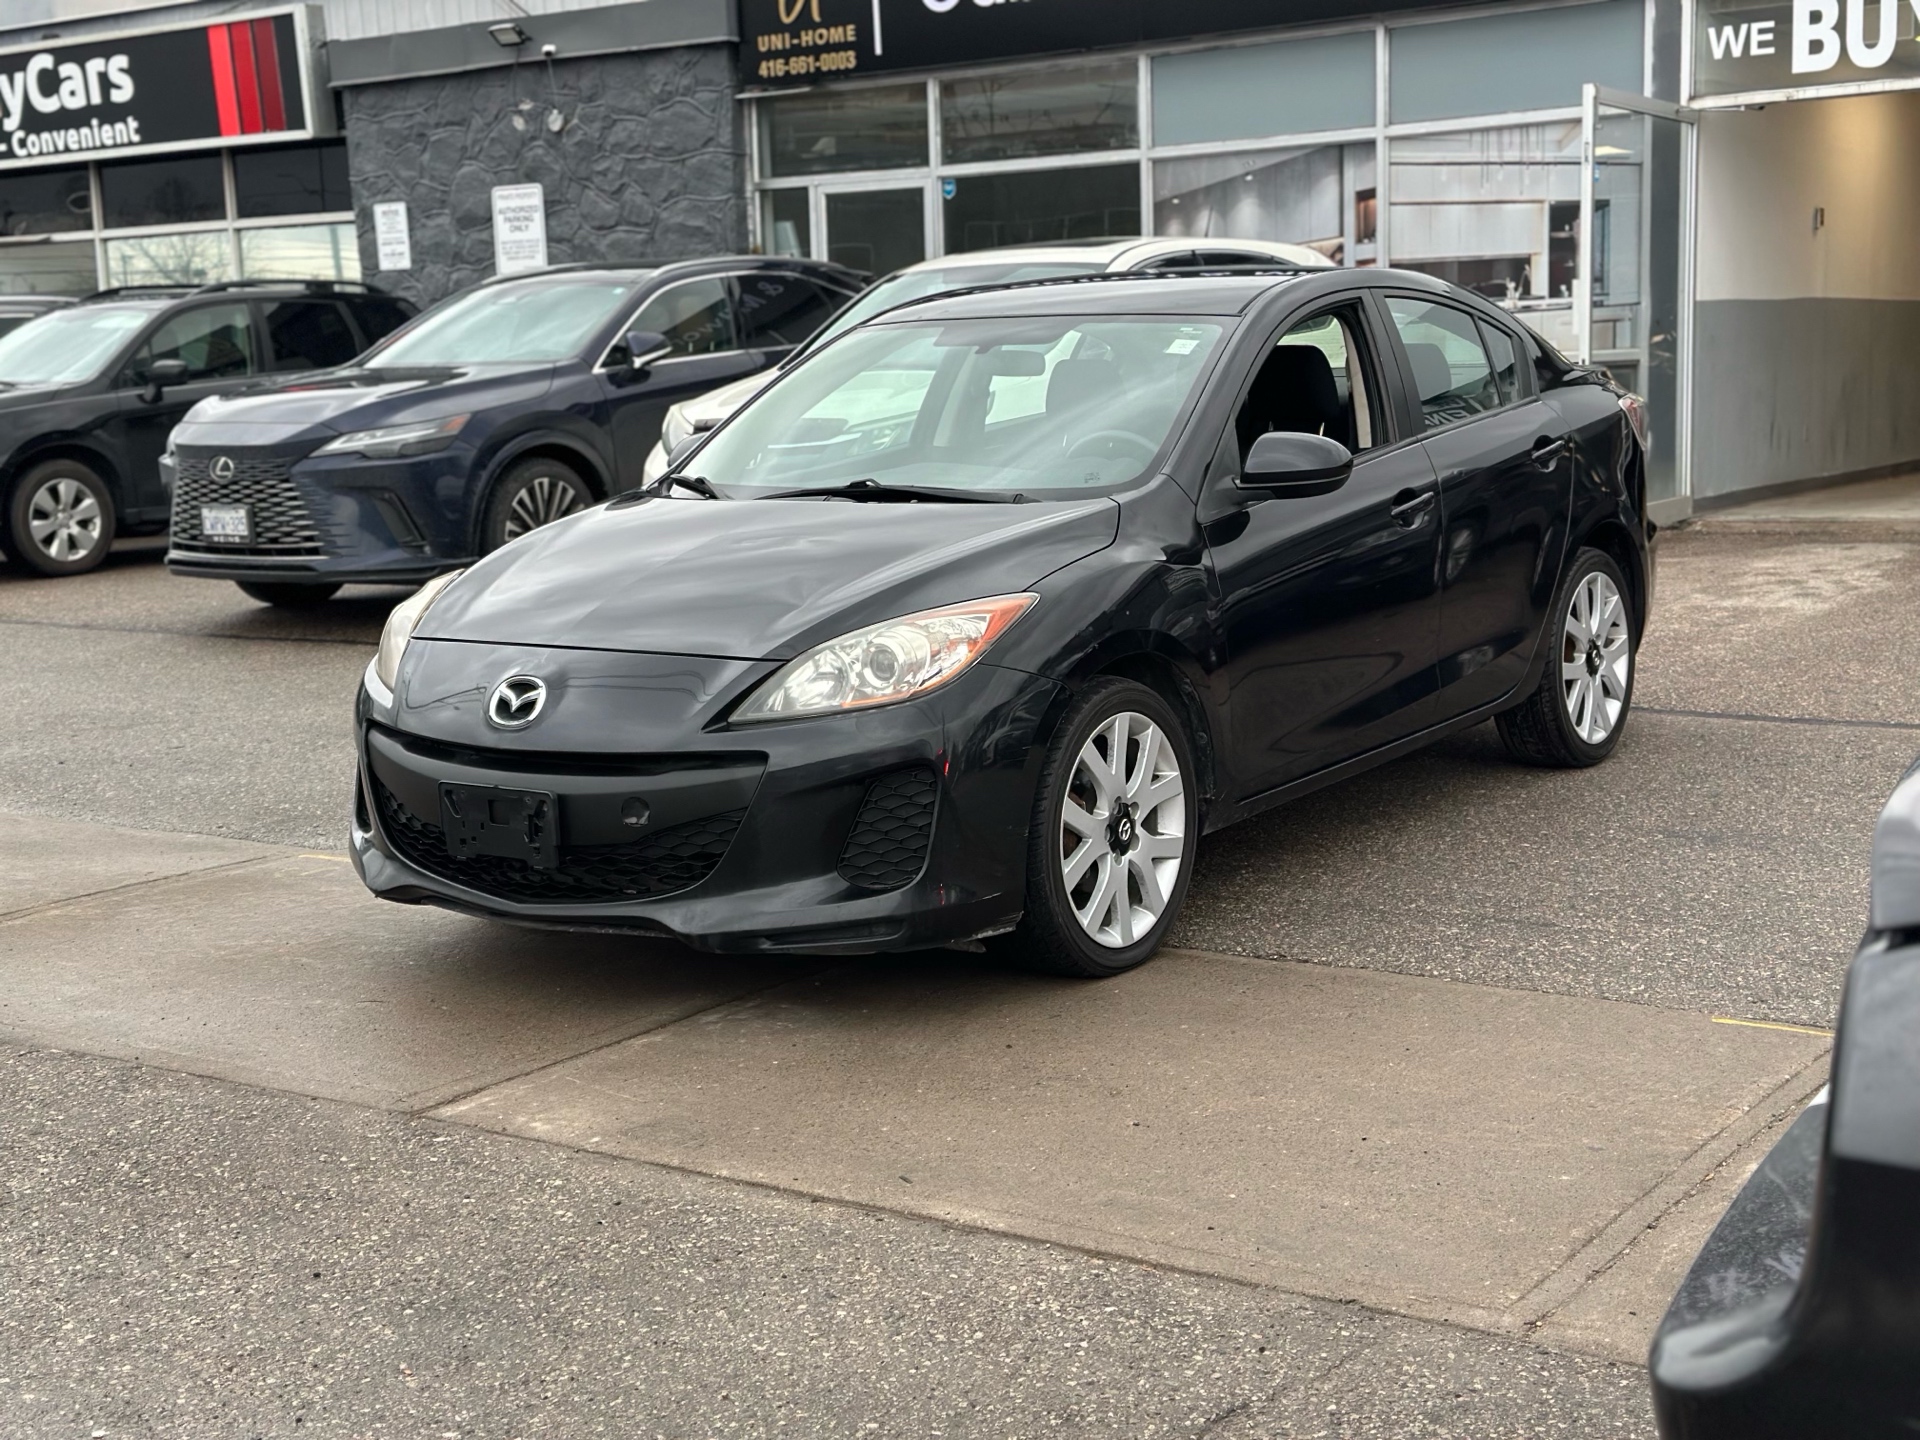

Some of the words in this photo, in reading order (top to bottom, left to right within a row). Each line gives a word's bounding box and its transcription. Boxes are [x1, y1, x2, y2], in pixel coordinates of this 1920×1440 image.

[757, 23, 857, 52] UNI-HOME
[1707, 20, 1776, 60] WE
[1791, 0, 1920, 74] BU
[758, 50, 857, 78] 416-661-0003
[11, 115, 141, 157] Convenient
[498, 205, 540, 215] AUTHORIZED
[503, 214, 534, 224] PARKING
[509, 224, 529, 233] ONLY
